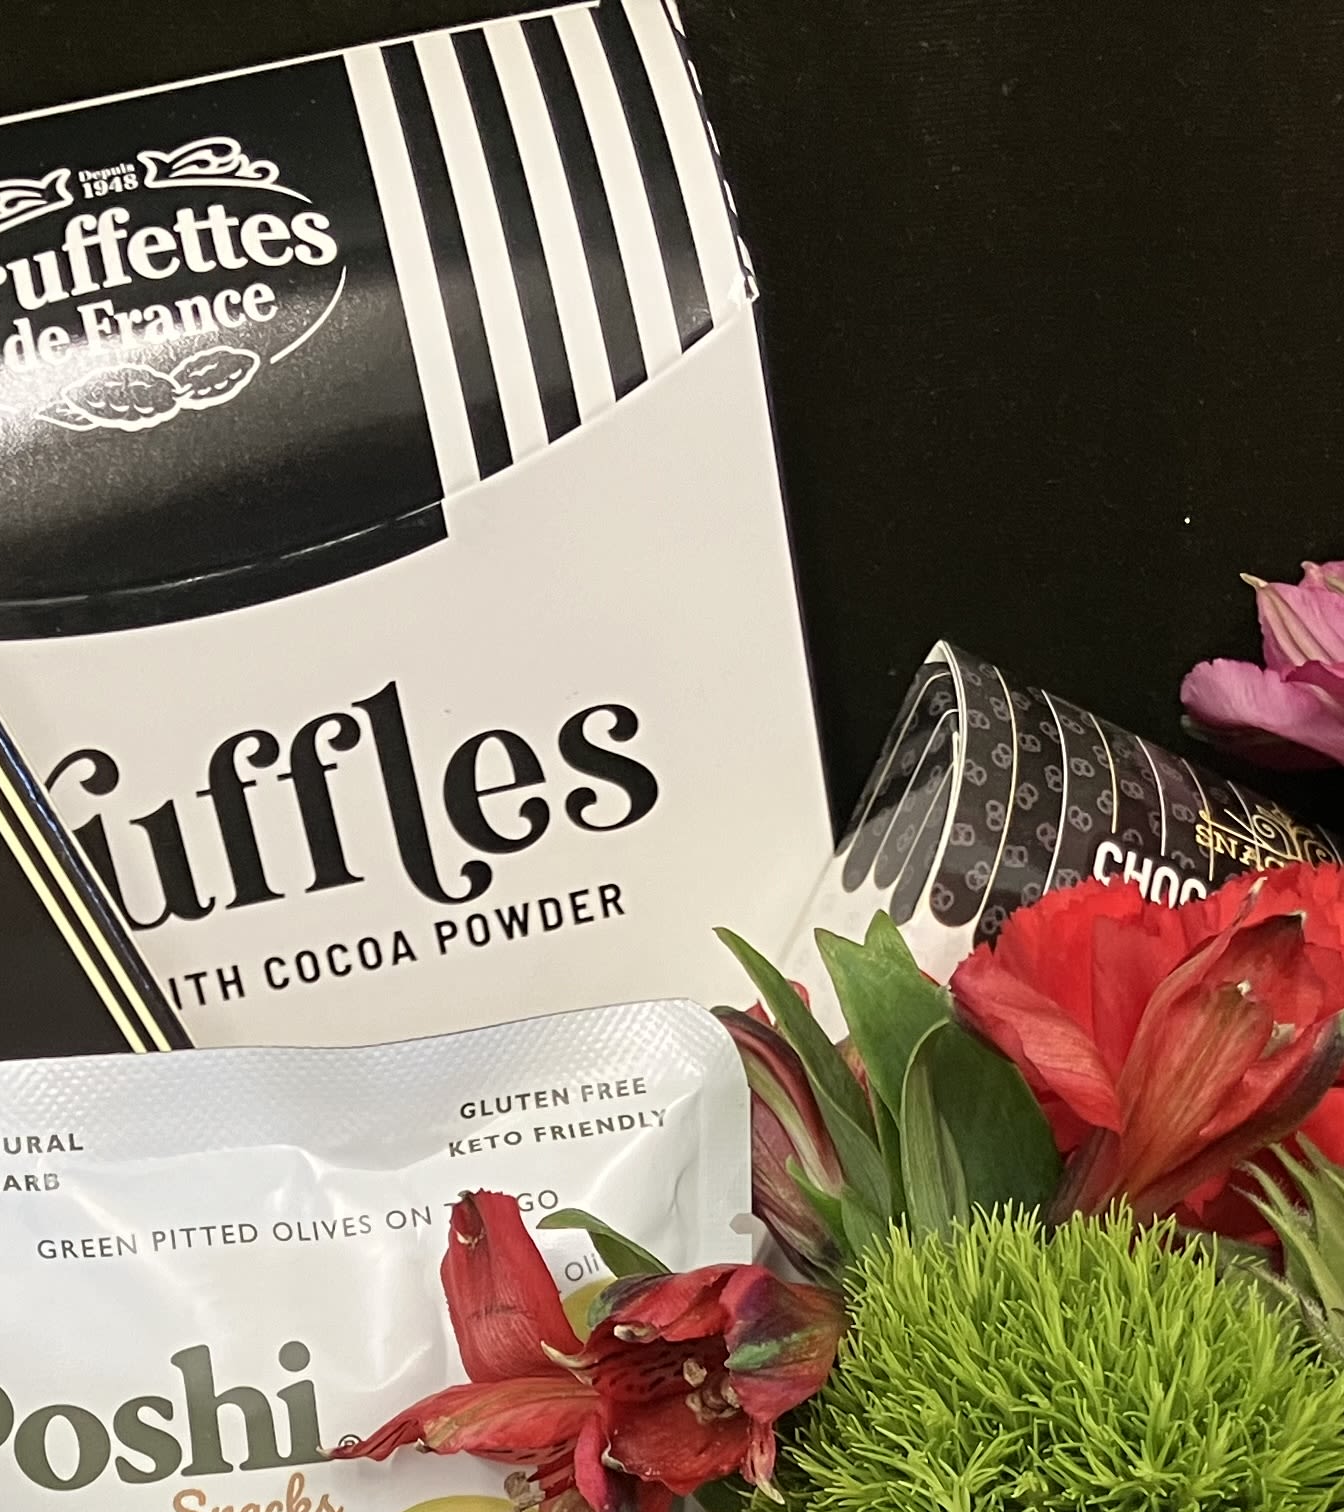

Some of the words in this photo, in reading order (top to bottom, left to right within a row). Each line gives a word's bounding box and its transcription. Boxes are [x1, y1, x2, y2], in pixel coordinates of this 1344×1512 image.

[82, 173, 139, 199] 1948
[3, 317, 71, 372] de
[77, 282, 278, 358] France
[264, 930, 417, 991] COCOA
[434, 883, 625, 955] POWDER
[459, 1087, 569, 1121] GLUTEN
[580, 1076, 648, 1104] FREE
[448, 1129, 523, 1158] KETO
[533, 1108, 669, 1145] FRIENDLY
[36, 1233, 139, 1261] GREEN
[150, 1222, 258, 1253] PITTED
[272, 1213, 372, 1242] OLIVES
[385, 1205, 433, 1232] ON
[517, 1189, 559, 1212] GO
